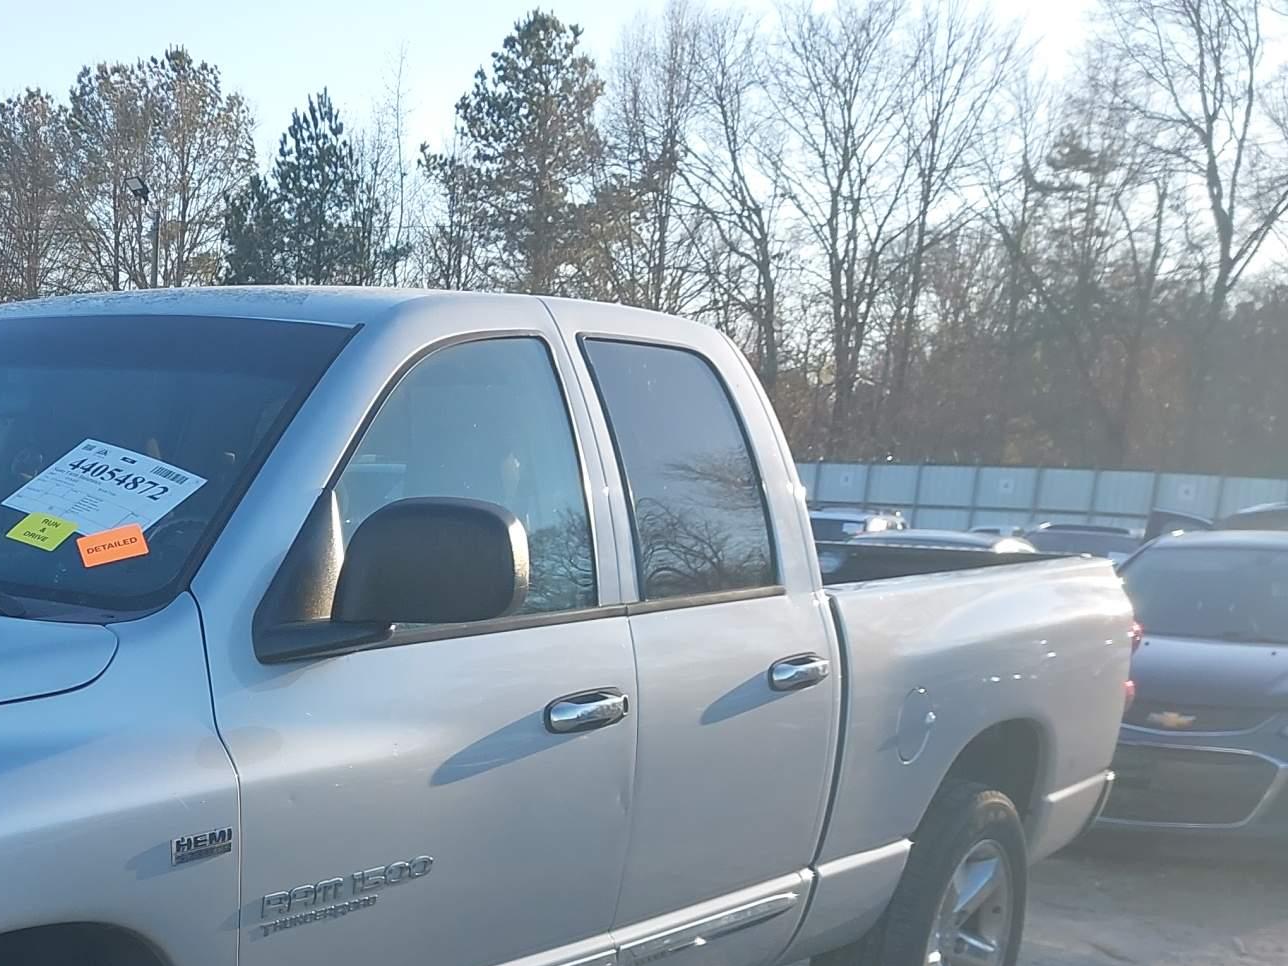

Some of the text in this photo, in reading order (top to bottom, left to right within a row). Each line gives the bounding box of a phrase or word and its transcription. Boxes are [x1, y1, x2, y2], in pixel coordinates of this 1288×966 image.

[69, 458, 170, 501] 44054872
[40, 518, 60, 528] RUN
[23, 530, 49, 542] DRIVE
[86, 536, 138, 555] DETAILED
[175, 828, 232, 853] HEMI
[261, 855, 434, 920] RAM 1500
